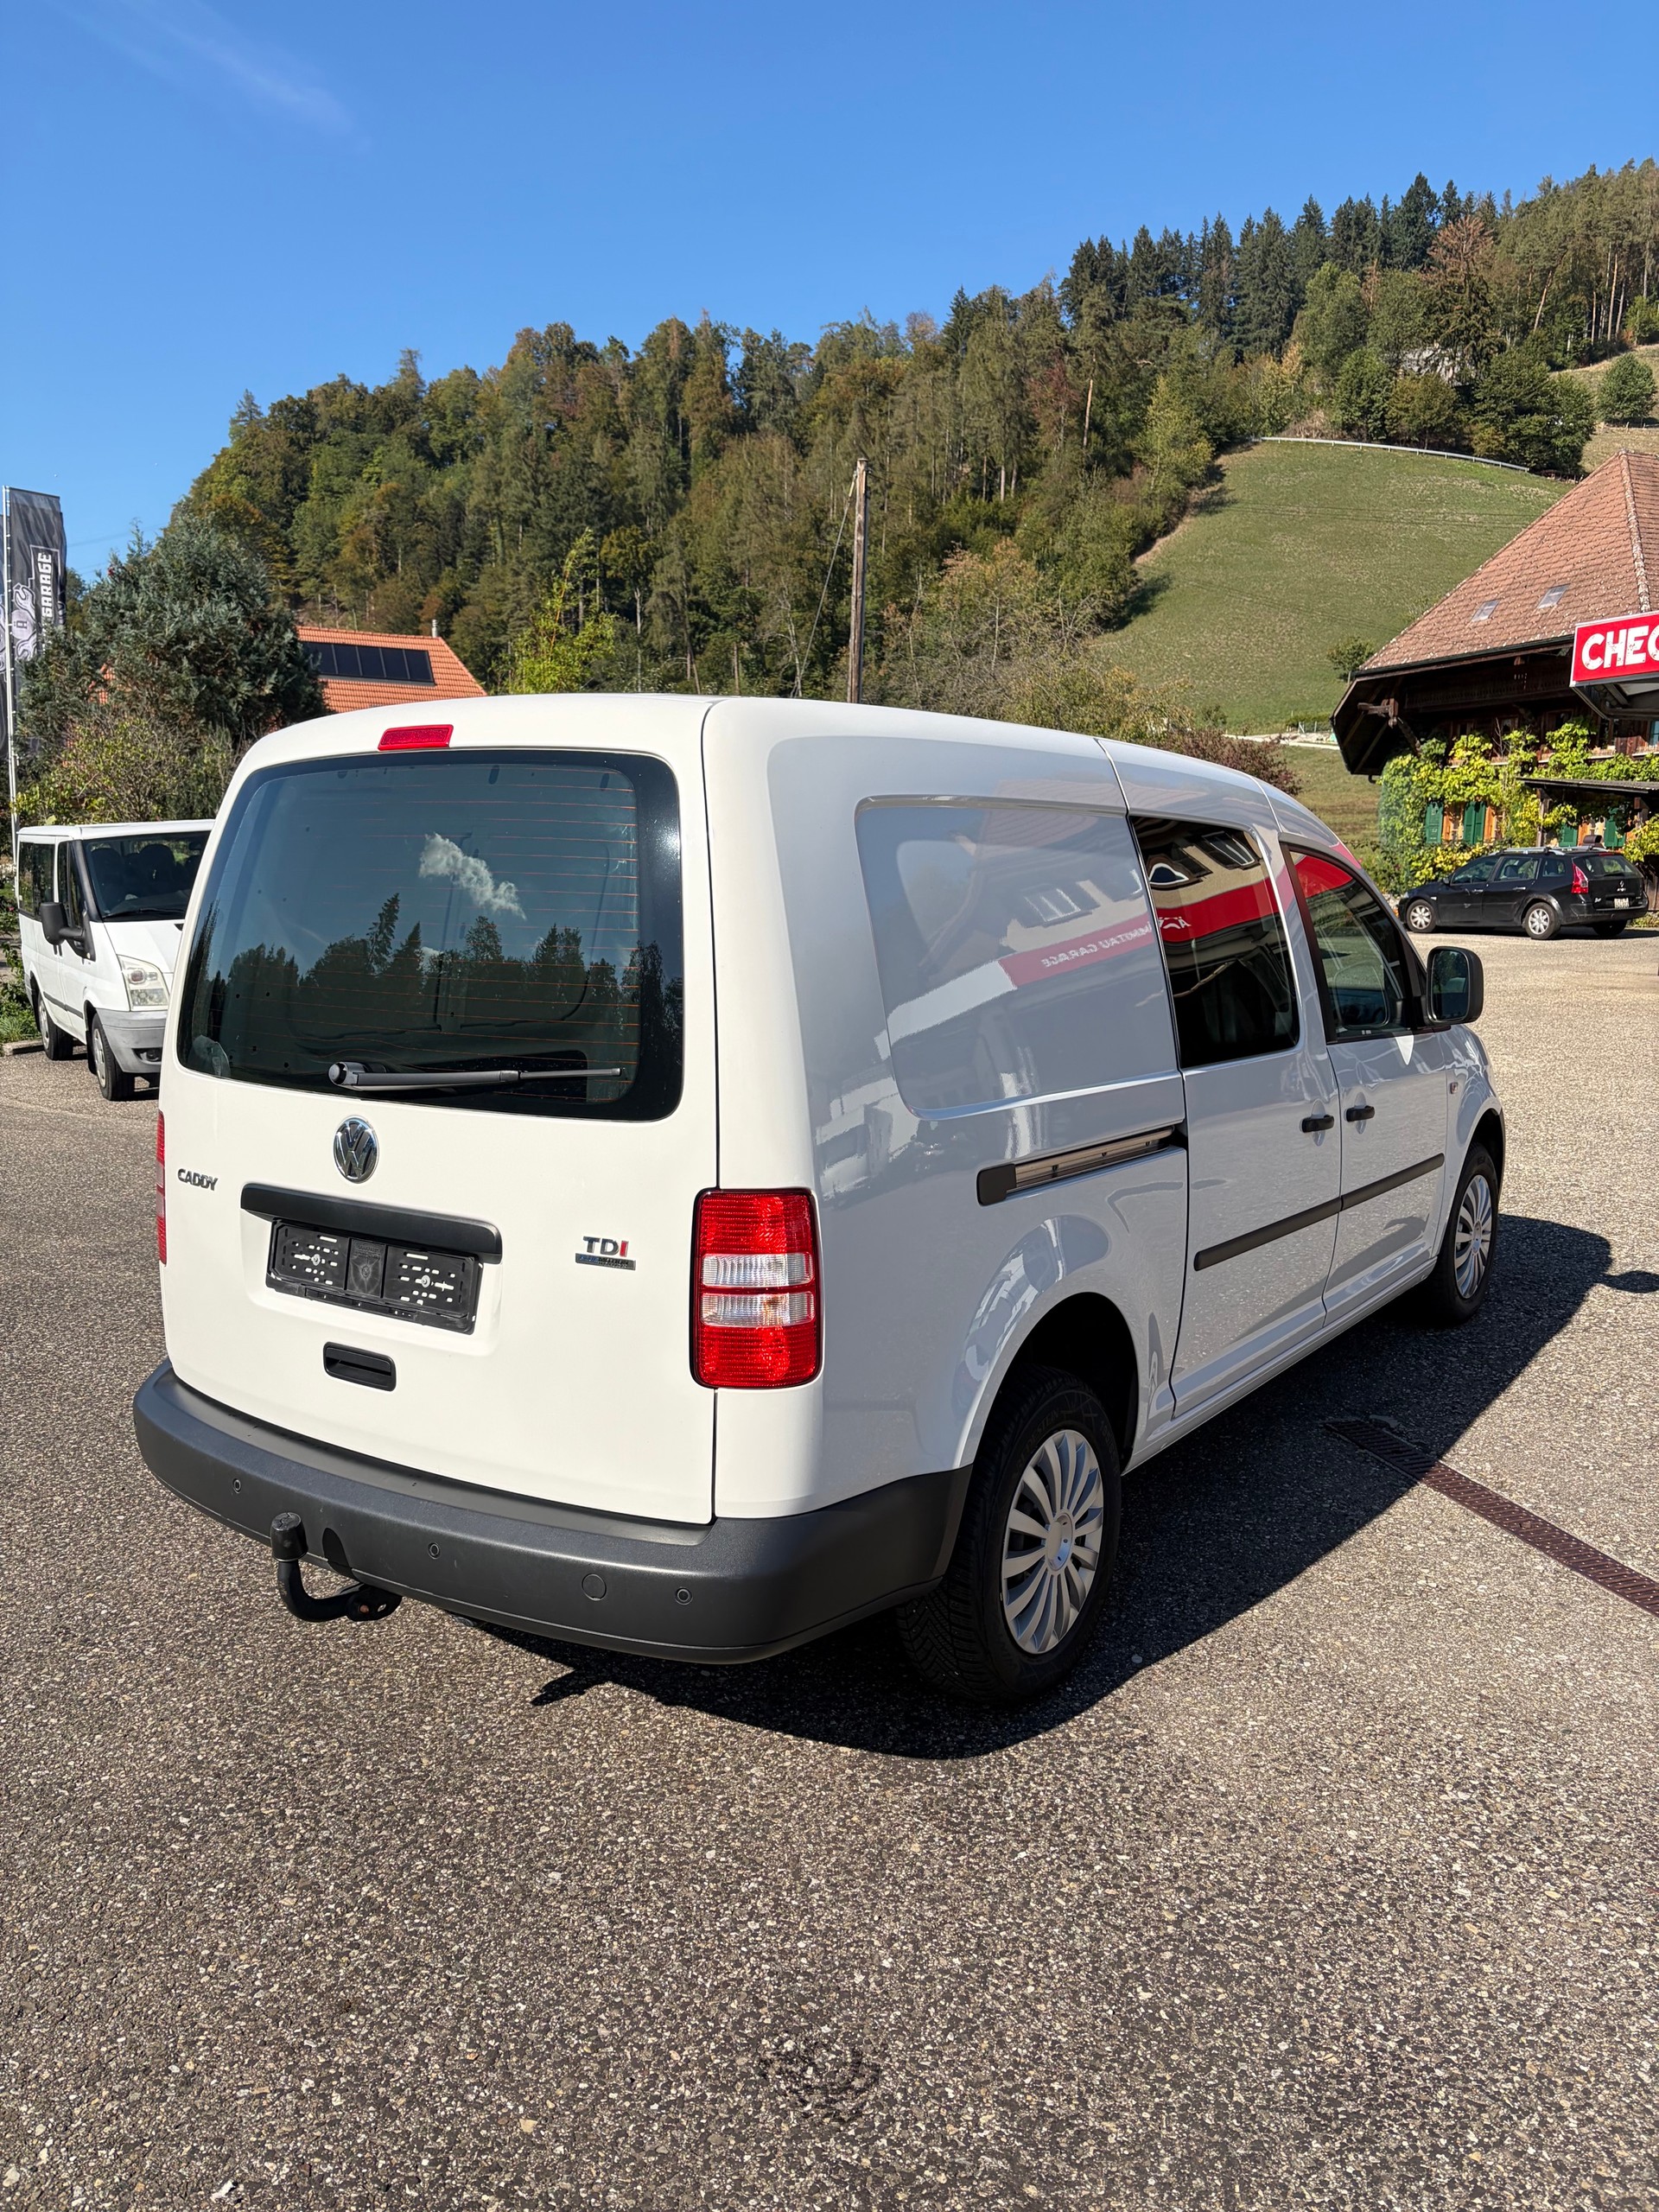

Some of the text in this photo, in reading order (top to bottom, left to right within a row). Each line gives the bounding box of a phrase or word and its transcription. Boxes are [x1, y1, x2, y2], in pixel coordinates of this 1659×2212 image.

[37, 552, 52, 618] GARAGE
[177, 1168, 219, 1191] CADDY
[583, 1236, 629, 1257] TDI
